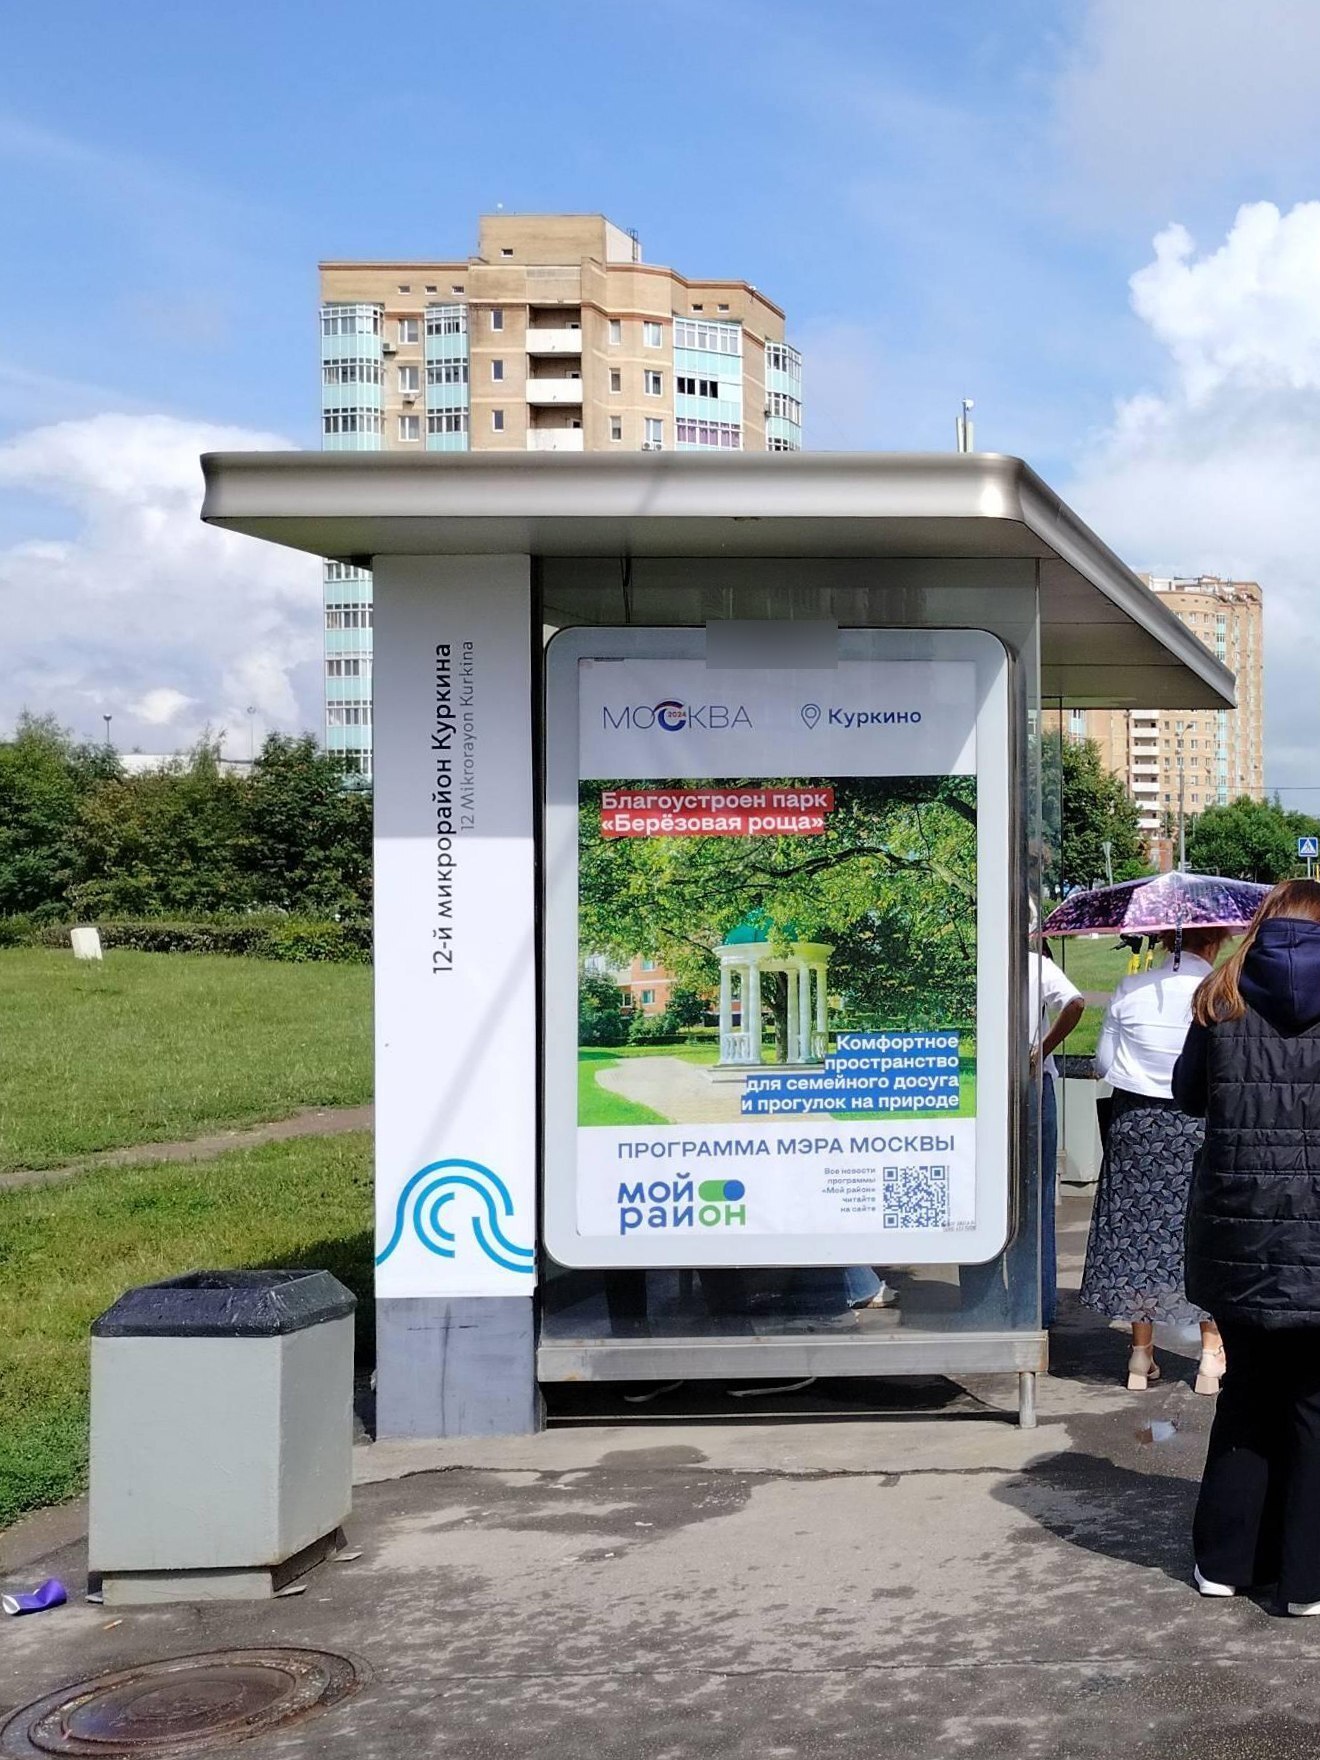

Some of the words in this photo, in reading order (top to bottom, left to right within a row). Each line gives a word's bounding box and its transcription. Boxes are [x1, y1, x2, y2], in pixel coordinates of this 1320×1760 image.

[459, 640, 474, 706] Kurkina
[431, 643, 456, 751] Куркина
[602, 699, 753, 732] МОСКВА
[828, 708, 922, 728] Куркино
[459, 712, 477, 807] Mikrorayon
[602, 792, 766, 814] Благоустроен
[772, 792, 828, 812] парк
[460, 814, 475, 830] 12
[601, 813, 742, 835] «Берёзовая
[748, 815, 825, 835] роща»
[432, 759, 456, 919] микрорайон
[432, 926, 453, 974] 12-й
[836, 1035, 960, 1053] Комфортное
[824, 1055, 960, 1073] пространство
[746, 1078, 782, 1093] для
[785, 1074, 889, 1090] семейного
[893, 1075, 960, 1091] досуга
[741, 1099, 753, 1111] и
[757, 1096, 846, 1114] прогулок
[851, 1097, 875, 1109] на
[877, 1094, 960, 1112] природе
[618, 1139, 770, 1159] ПРОГРАММА
[777, 1136, 843, 1156] МЭРА
[850, 1134, 955, 1155] МОСКВЫ
[827, 1178, 876, 1186] программы
[841, 1167, 876, 1175] новости
[617, 1171, 694, 1204] мой
